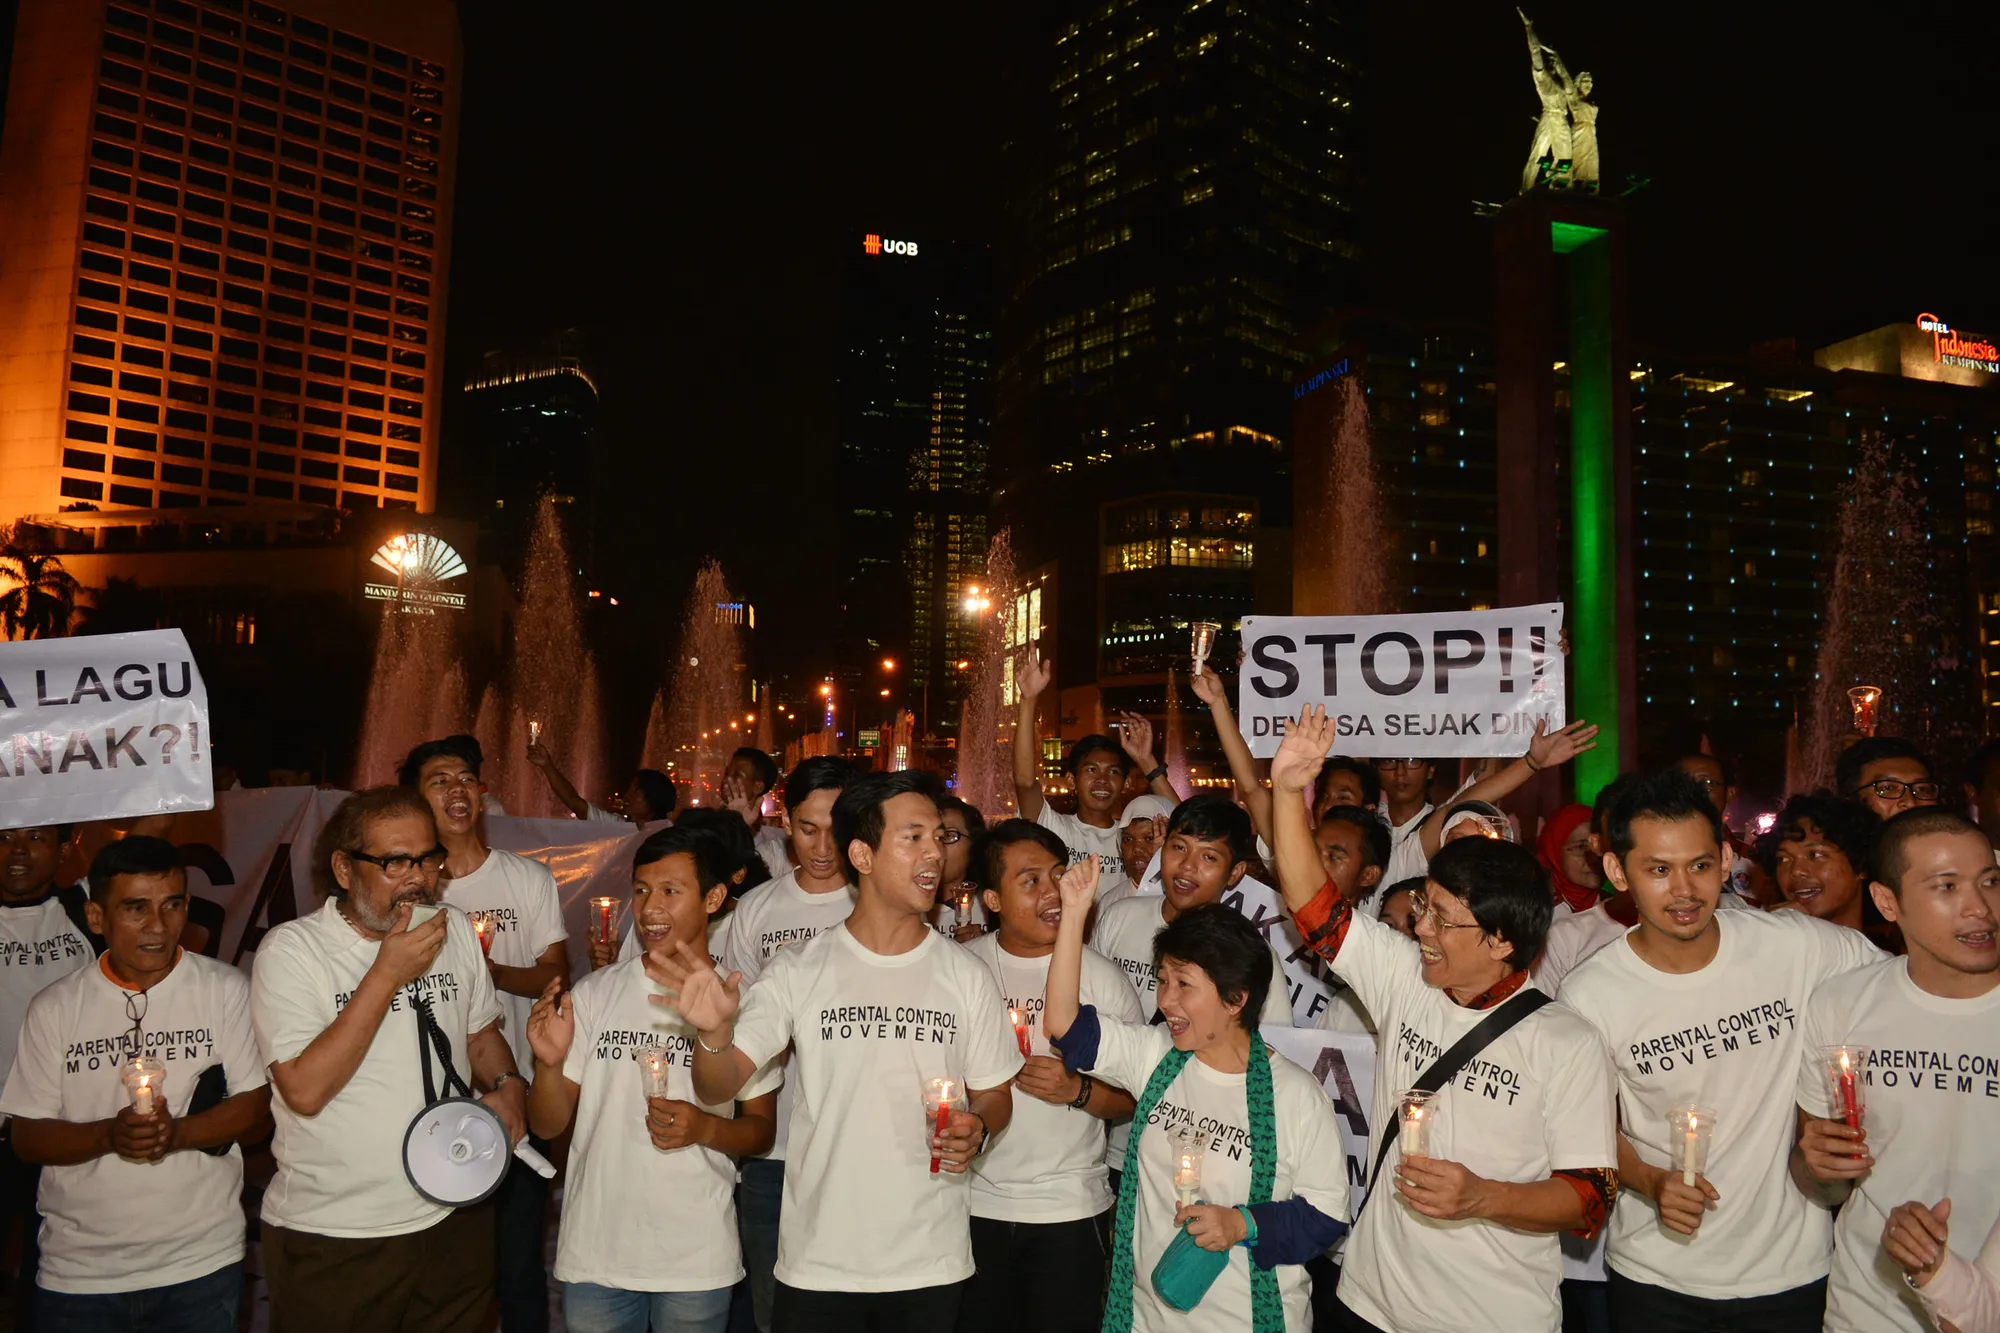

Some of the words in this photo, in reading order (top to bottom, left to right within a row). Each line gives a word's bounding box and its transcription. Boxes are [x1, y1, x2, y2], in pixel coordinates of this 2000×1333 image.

[883, 239, 918, 256] UOB
[1917, 312, 2000, 366] Indonesia
[1920, 320, 1950, 334] HOTEL
[1942, 354, 1999, 374] KEMPINSKI
[1294, 358, 1349, 400] KEMPINSKI
[400, 604, 435, 616] AKARTA
[1250, 626, 1546, 699] STOP!!
[35, 661, 192, 707] LAGU
[1252, 714, 1375, 737] DESA
[1384, 713, 1482, 737] SEJAK
[0, 721, 200, 779] NAK?!
[820, 1006, 891, 1025] PARENTAL
[895, 1006, 957, 1030] CONTROL
[1630, 1024, 1716, 1061] PARENTAL
[1717, 997, 1794, 1036] CONTROL
[66, 1032, 142, 1059] PARENTAL
[145, 1028, 213, 1047] CONTROL
[598, 1030, 661, 1048] PARENTAL
[821, 1024, 956, 1046] MOVEMENT
[1636, 1014, 1796, 1077] MOVEMENT
[1857, 1049, 1953, 1071] PARENTAL
[1460, 1058, 1521, 1090] ONTROL
